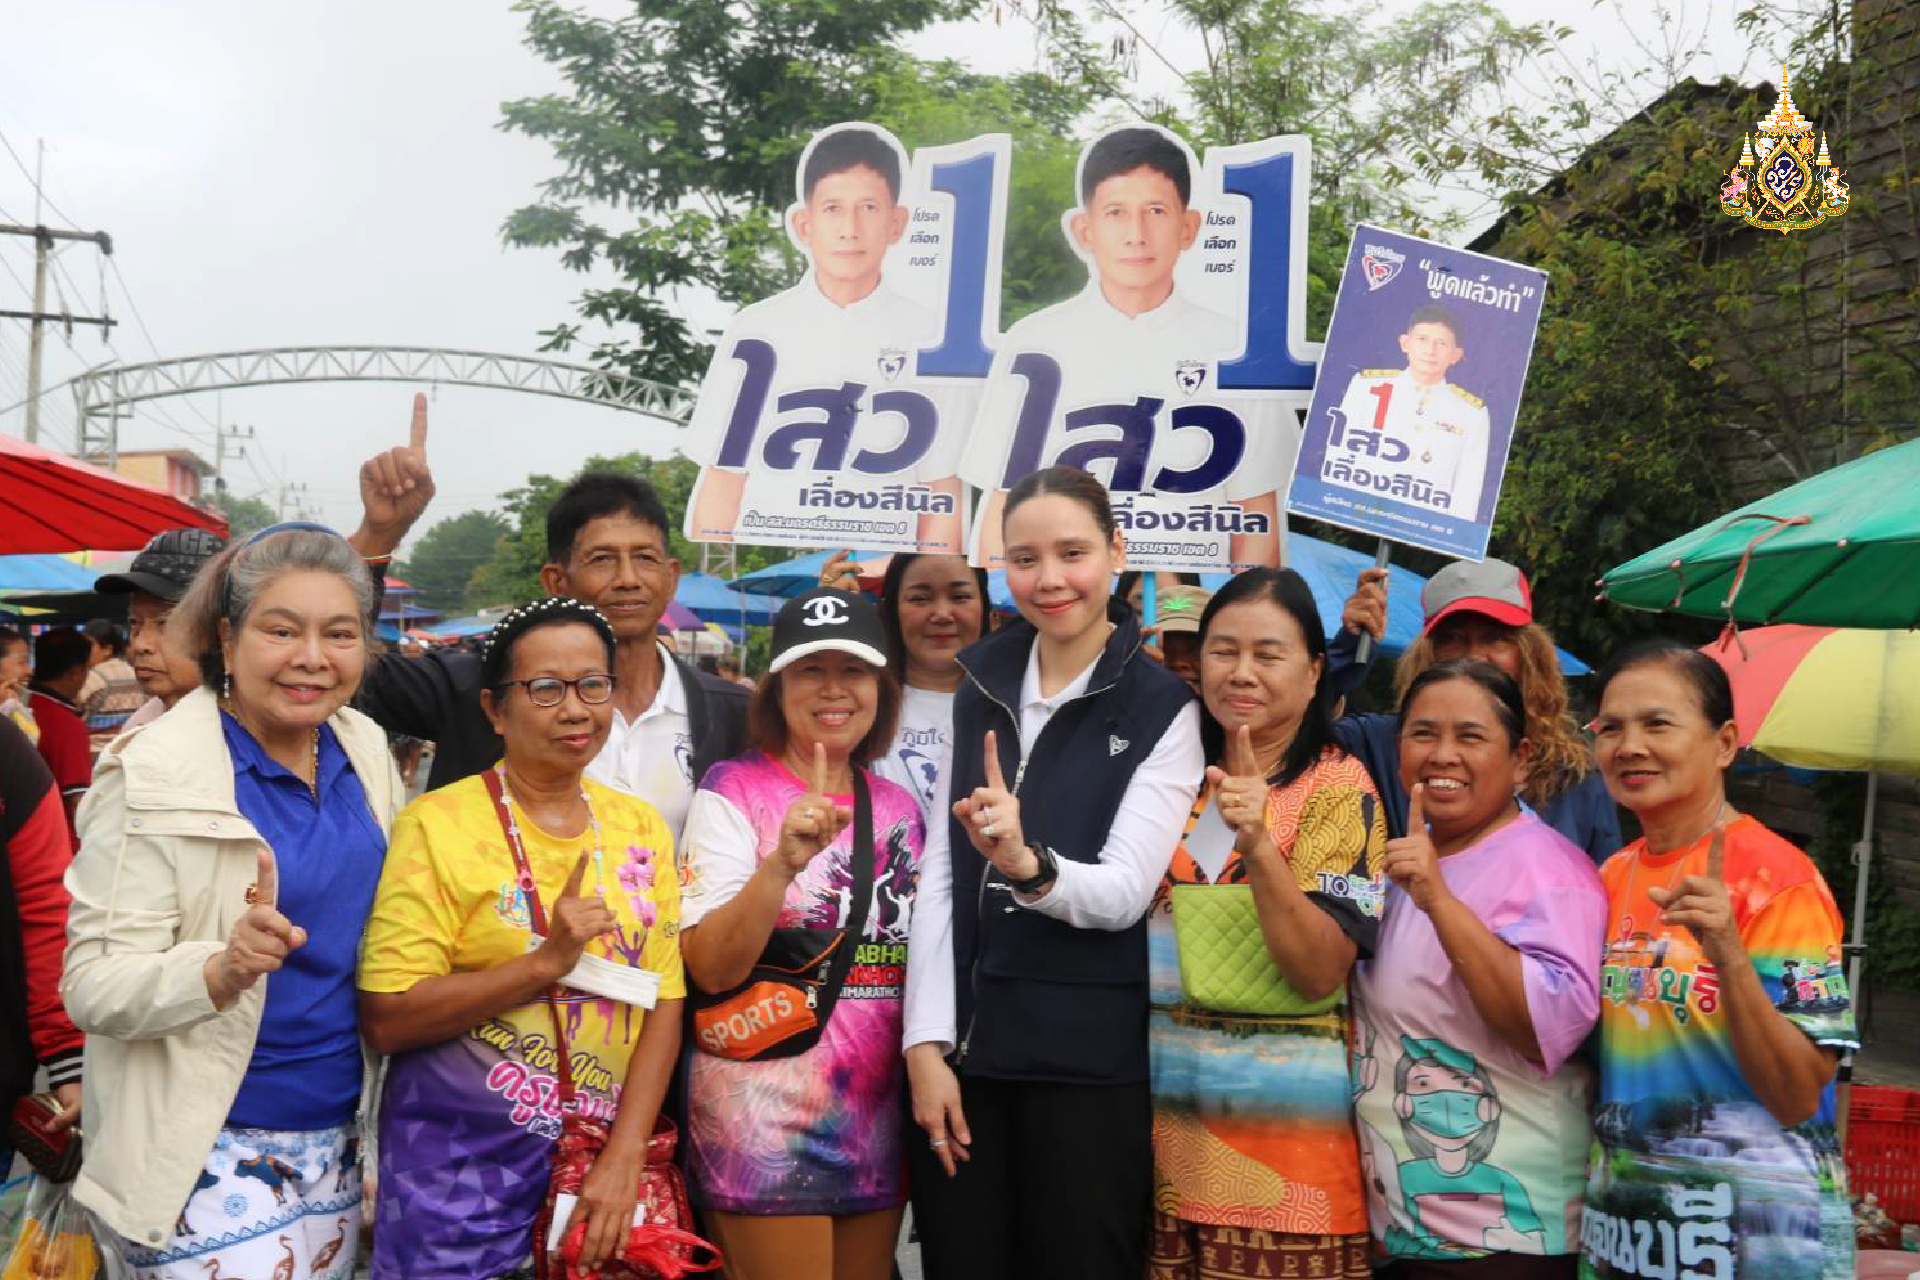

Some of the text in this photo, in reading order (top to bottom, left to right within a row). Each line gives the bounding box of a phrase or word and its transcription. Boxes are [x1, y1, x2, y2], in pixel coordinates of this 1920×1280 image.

[1205, 211, 1236, 226] โปรด
[1203, 235, 1237, 250] เลือก
[917, 152, 995, 377] 1
[1204, 259, 1237, 274] เบอร์
[1218, 152, 1317, 390] 1
[1370, 383, 1393, 430] 1
[798, 476, 954, 515] เลื่องสีนิล
[1111, 497, 1269, 534] ลื่องสีนิล
[701, 990, 793, 1051] SPORTS
